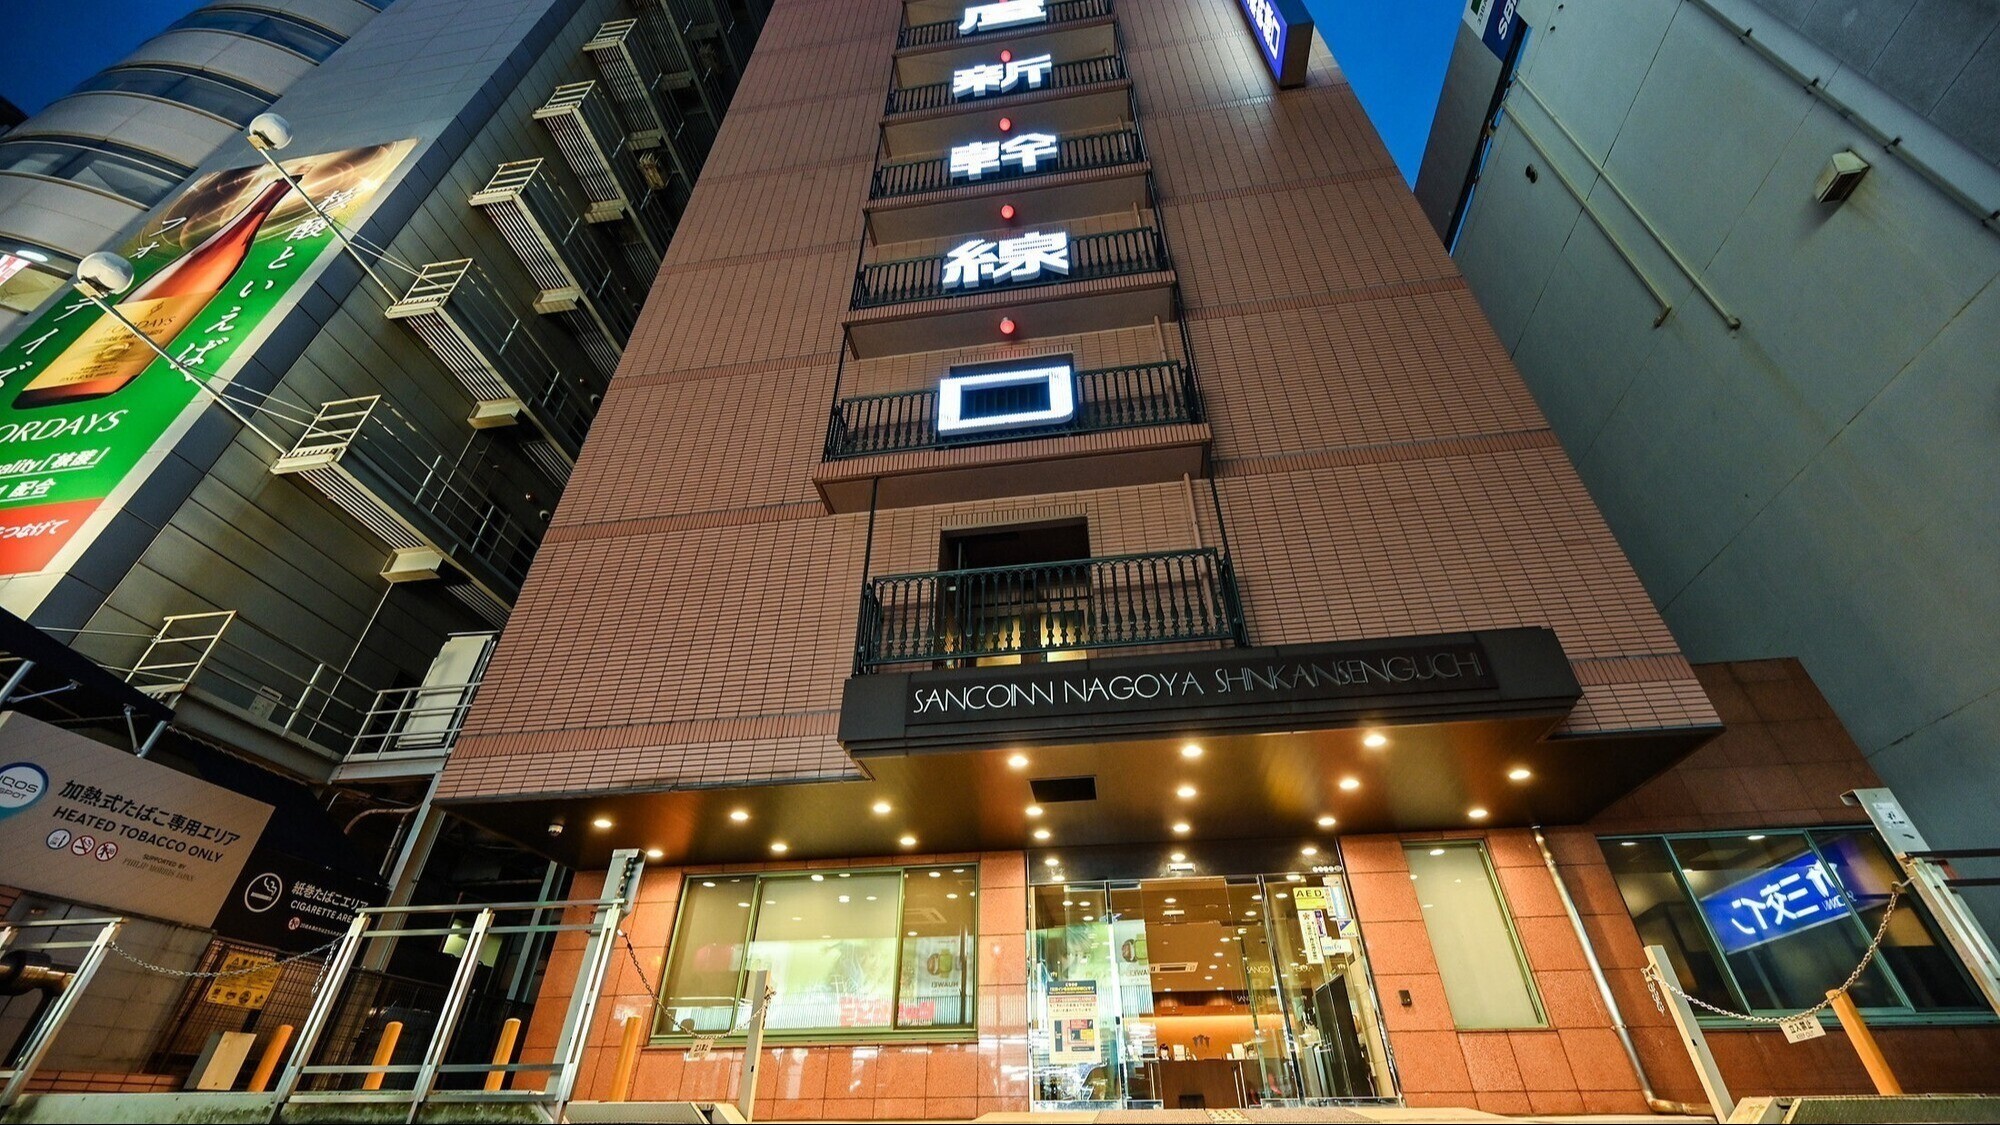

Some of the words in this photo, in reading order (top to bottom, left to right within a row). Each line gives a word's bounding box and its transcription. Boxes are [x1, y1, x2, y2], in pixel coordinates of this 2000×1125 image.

[1498, 0, 1518, 40] SB
[1064, 671, 1205, 704] NAGOYA
[1215, 651, 1484, 694] SHINKANSENGUCHI
[58, 779, 241, 847] 加熱式たばこ専用エリア
[52, 806, 117, 833] HEATED
[118, 825, 187, 853] TOBACCO
[188, 845, 224, 864] ONLY
[290, 900, 337, 919] CIGARETTE
[336, 912, 354, 923] ARE
[291, 880, 369, 910] 紙巻たばこエリア
[1296, 889, 1322, 898] AED
